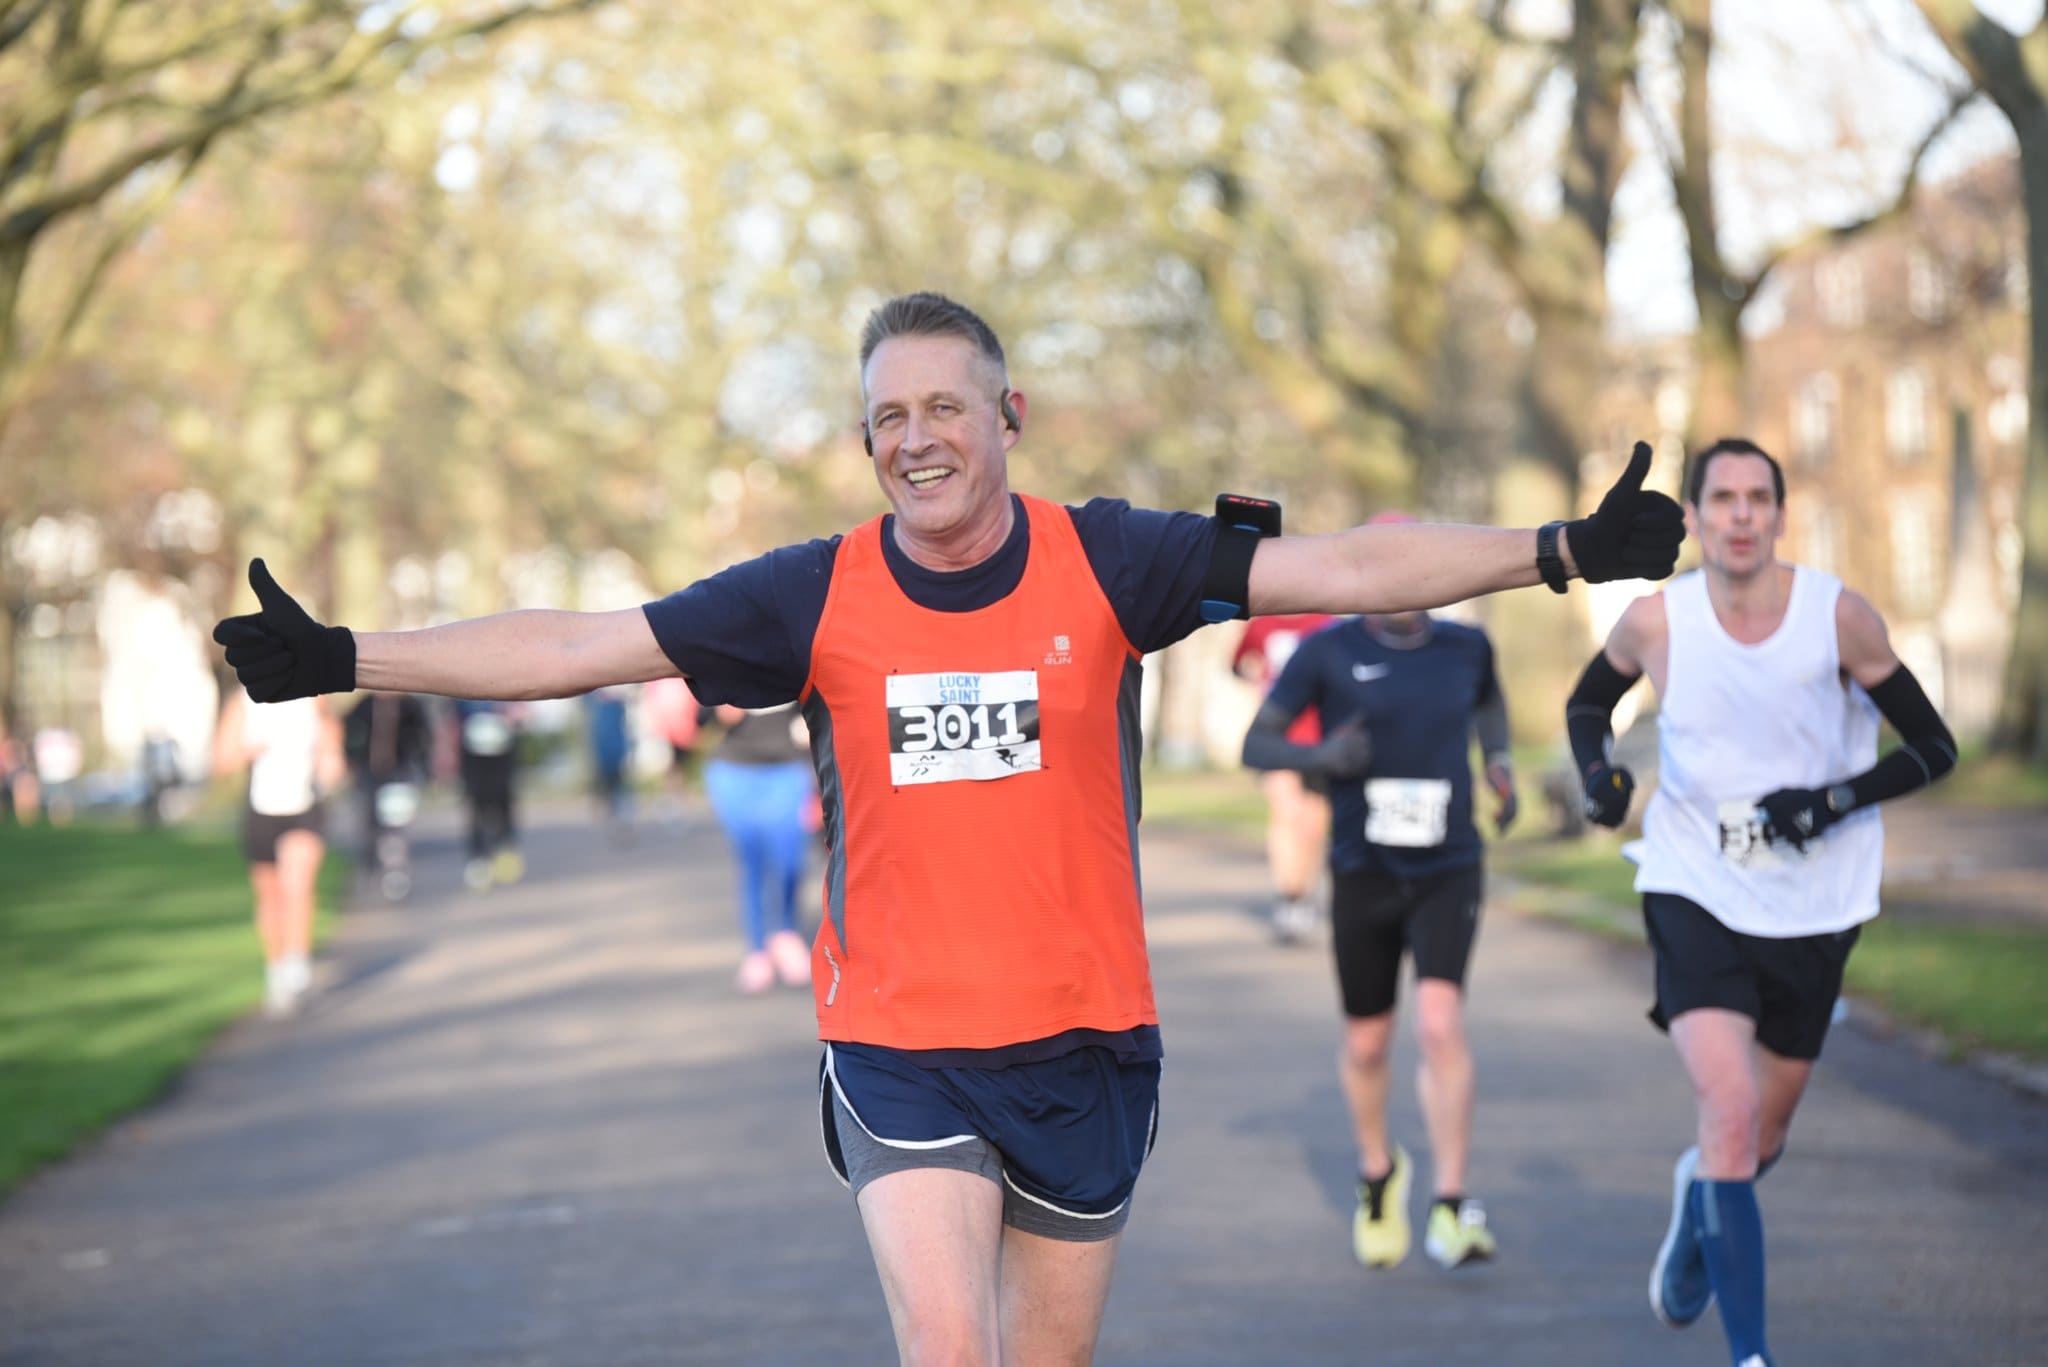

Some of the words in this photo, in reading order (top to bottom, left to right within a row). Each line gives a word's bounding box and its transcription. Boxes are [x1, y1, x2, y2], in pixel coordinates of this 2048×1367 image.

[939, 675, 981, 689] LUCKY
[939, 690, 981, 703] SAINT
[899, 703, 1027, 752] 3011
